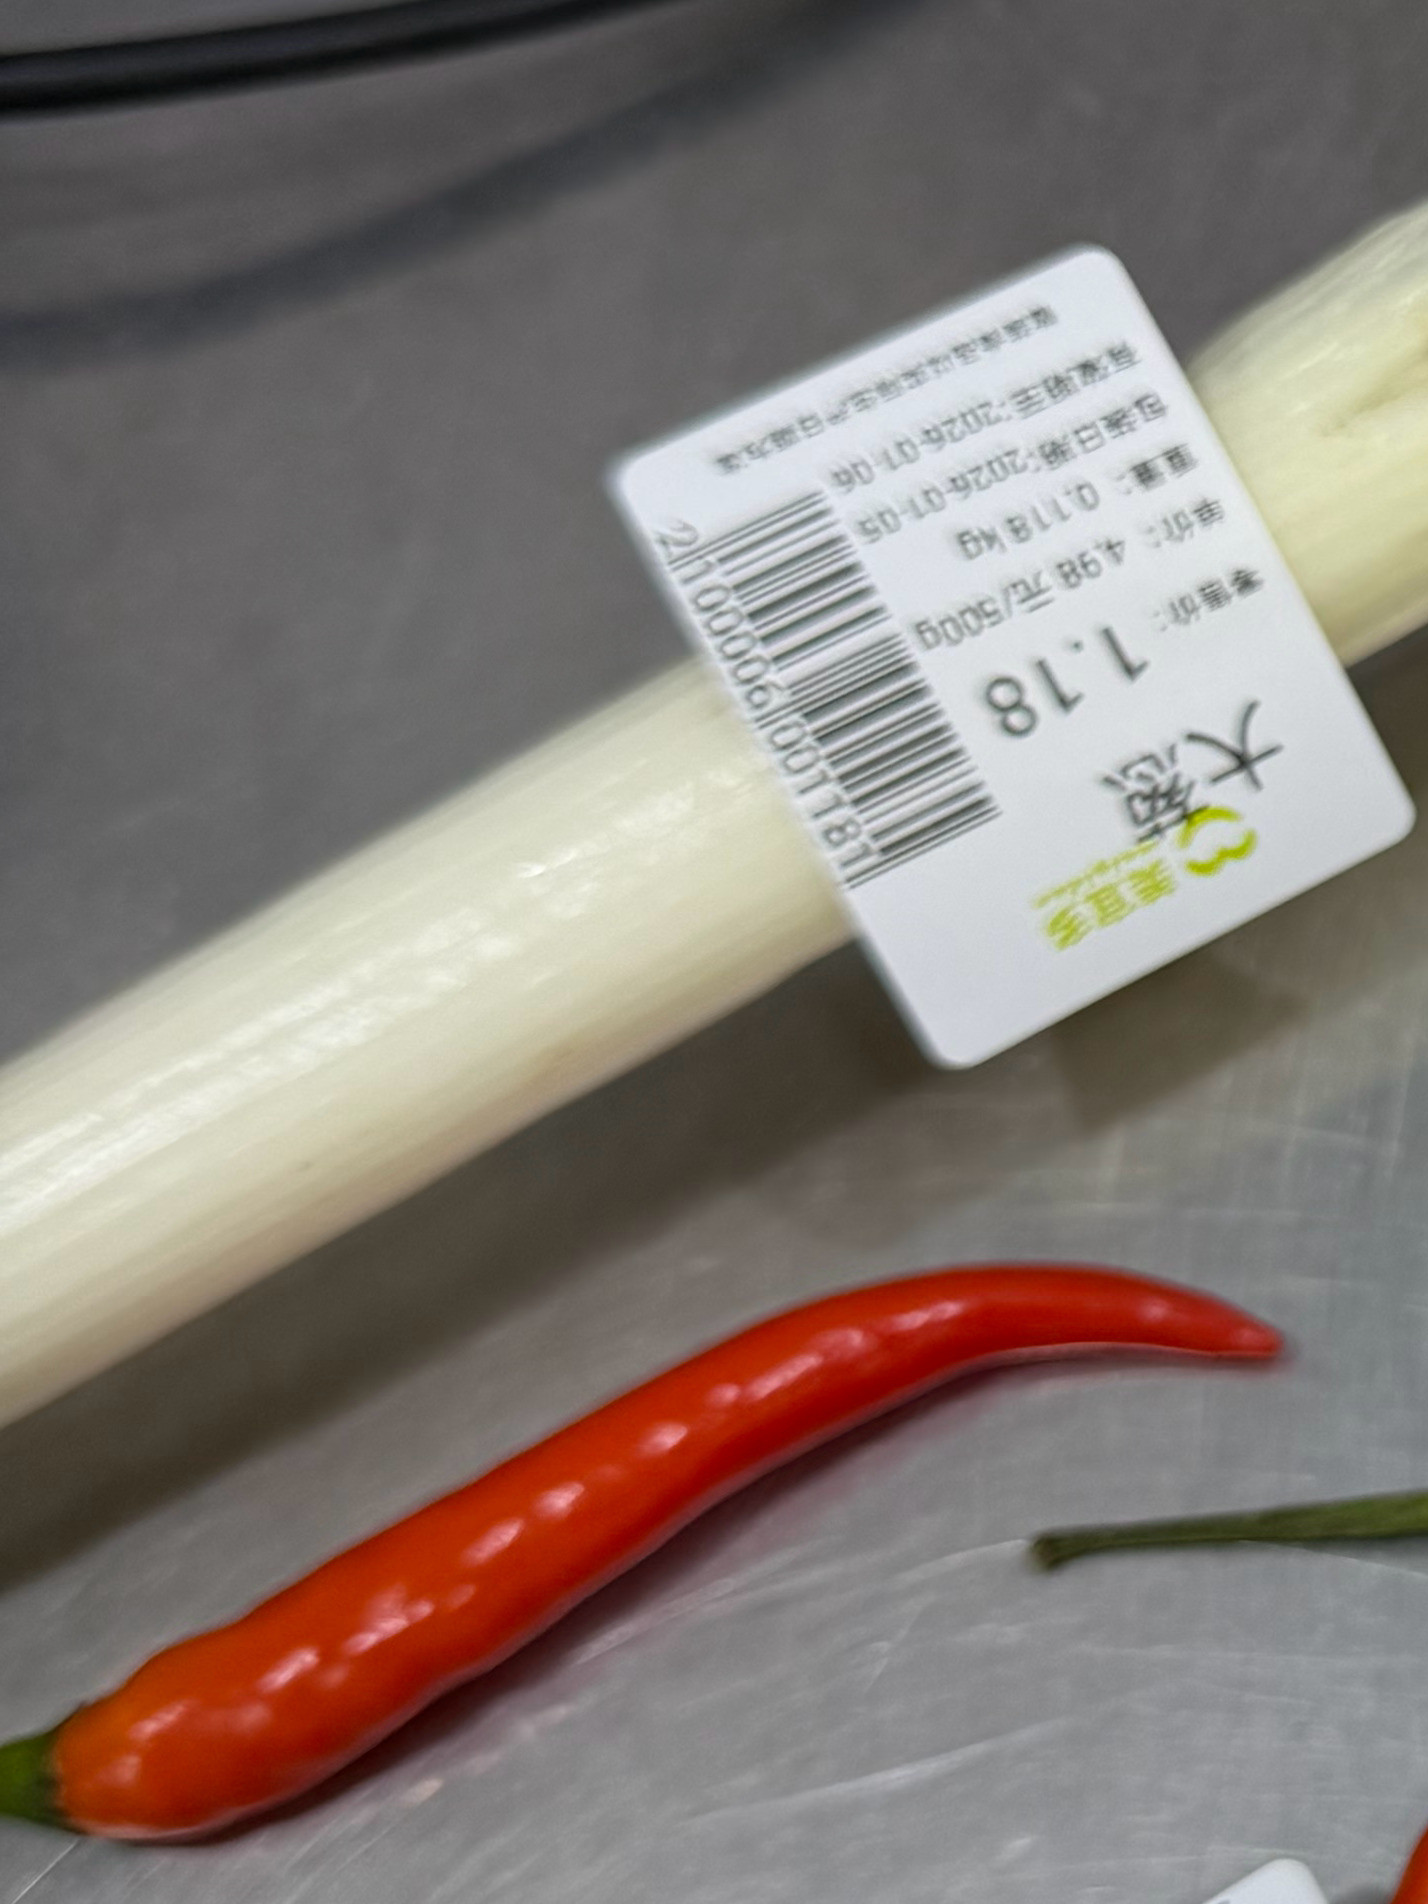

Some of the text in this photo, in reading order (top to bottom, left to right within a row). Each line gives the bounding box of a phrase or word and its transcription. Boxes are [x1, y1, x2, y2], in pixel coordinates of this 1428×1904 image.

[952, 526, 1007, 562] kg
[1001, 480, 1102, 546] 0.118
[1053, 537, 1126, 591] 4.98
[980, 625, 1150, 741] 1.18
[1099, 699, 1284, 847] 大葱
